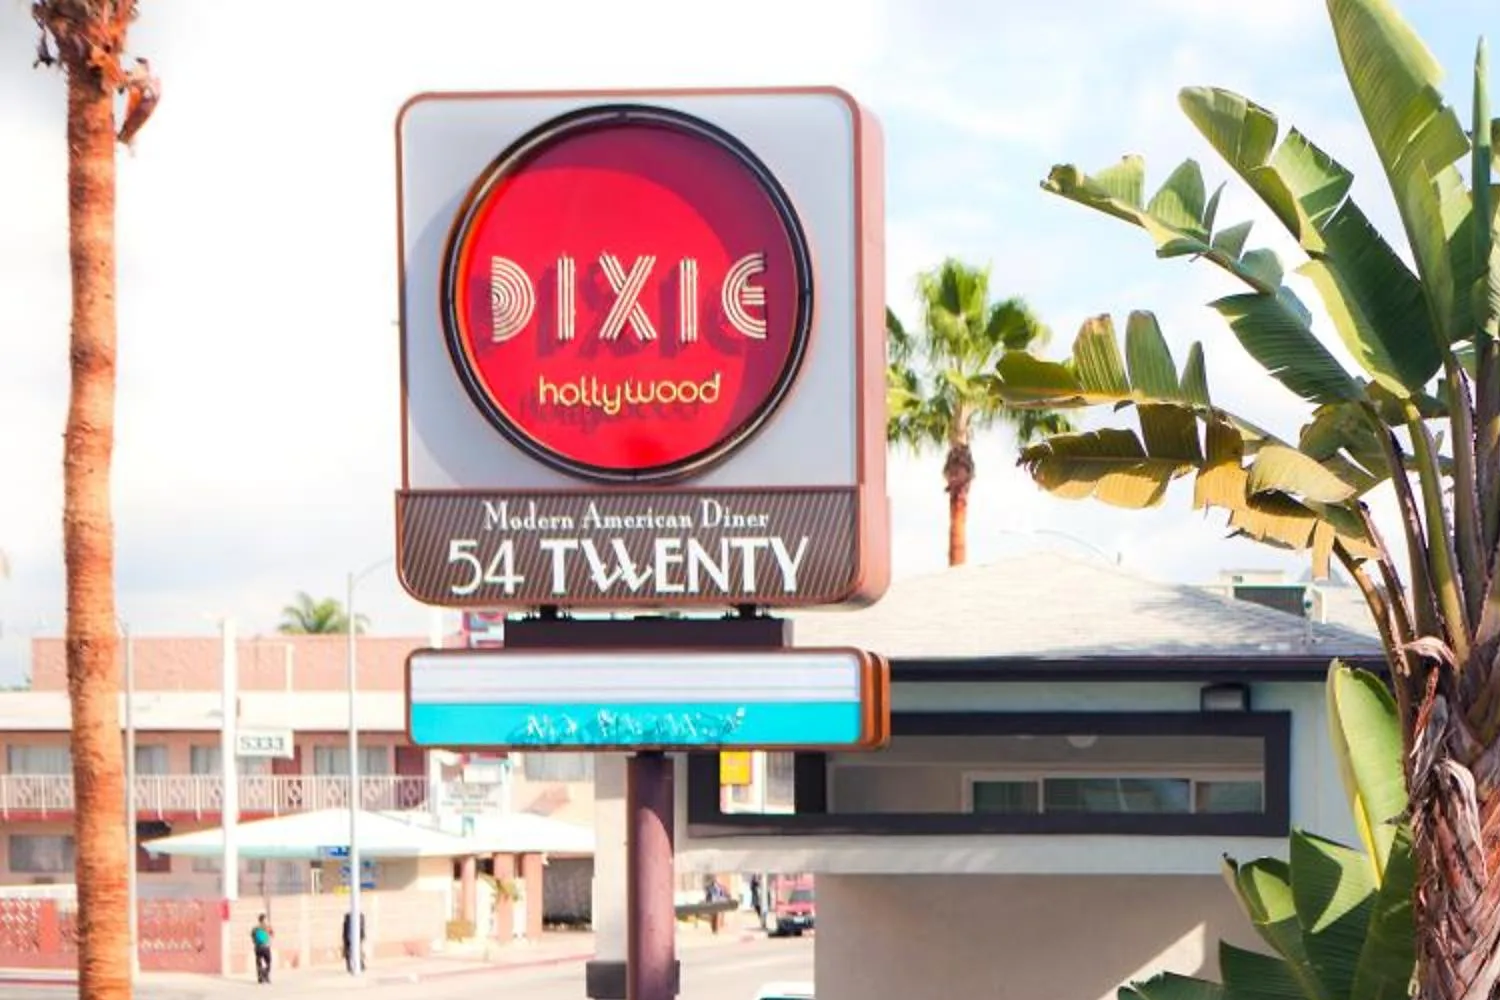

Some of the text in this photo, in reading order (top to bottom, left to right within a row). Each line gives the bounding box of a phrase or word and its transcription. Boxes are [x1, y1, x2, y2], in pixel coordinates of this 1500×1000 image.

[491, 252, 767, 342] DIXIE
[539, 371, 720, 414] hollywood
[483, 499, 769, 531] Modern American Diner
[448, 536, 809, 595] 54 TWENTY
